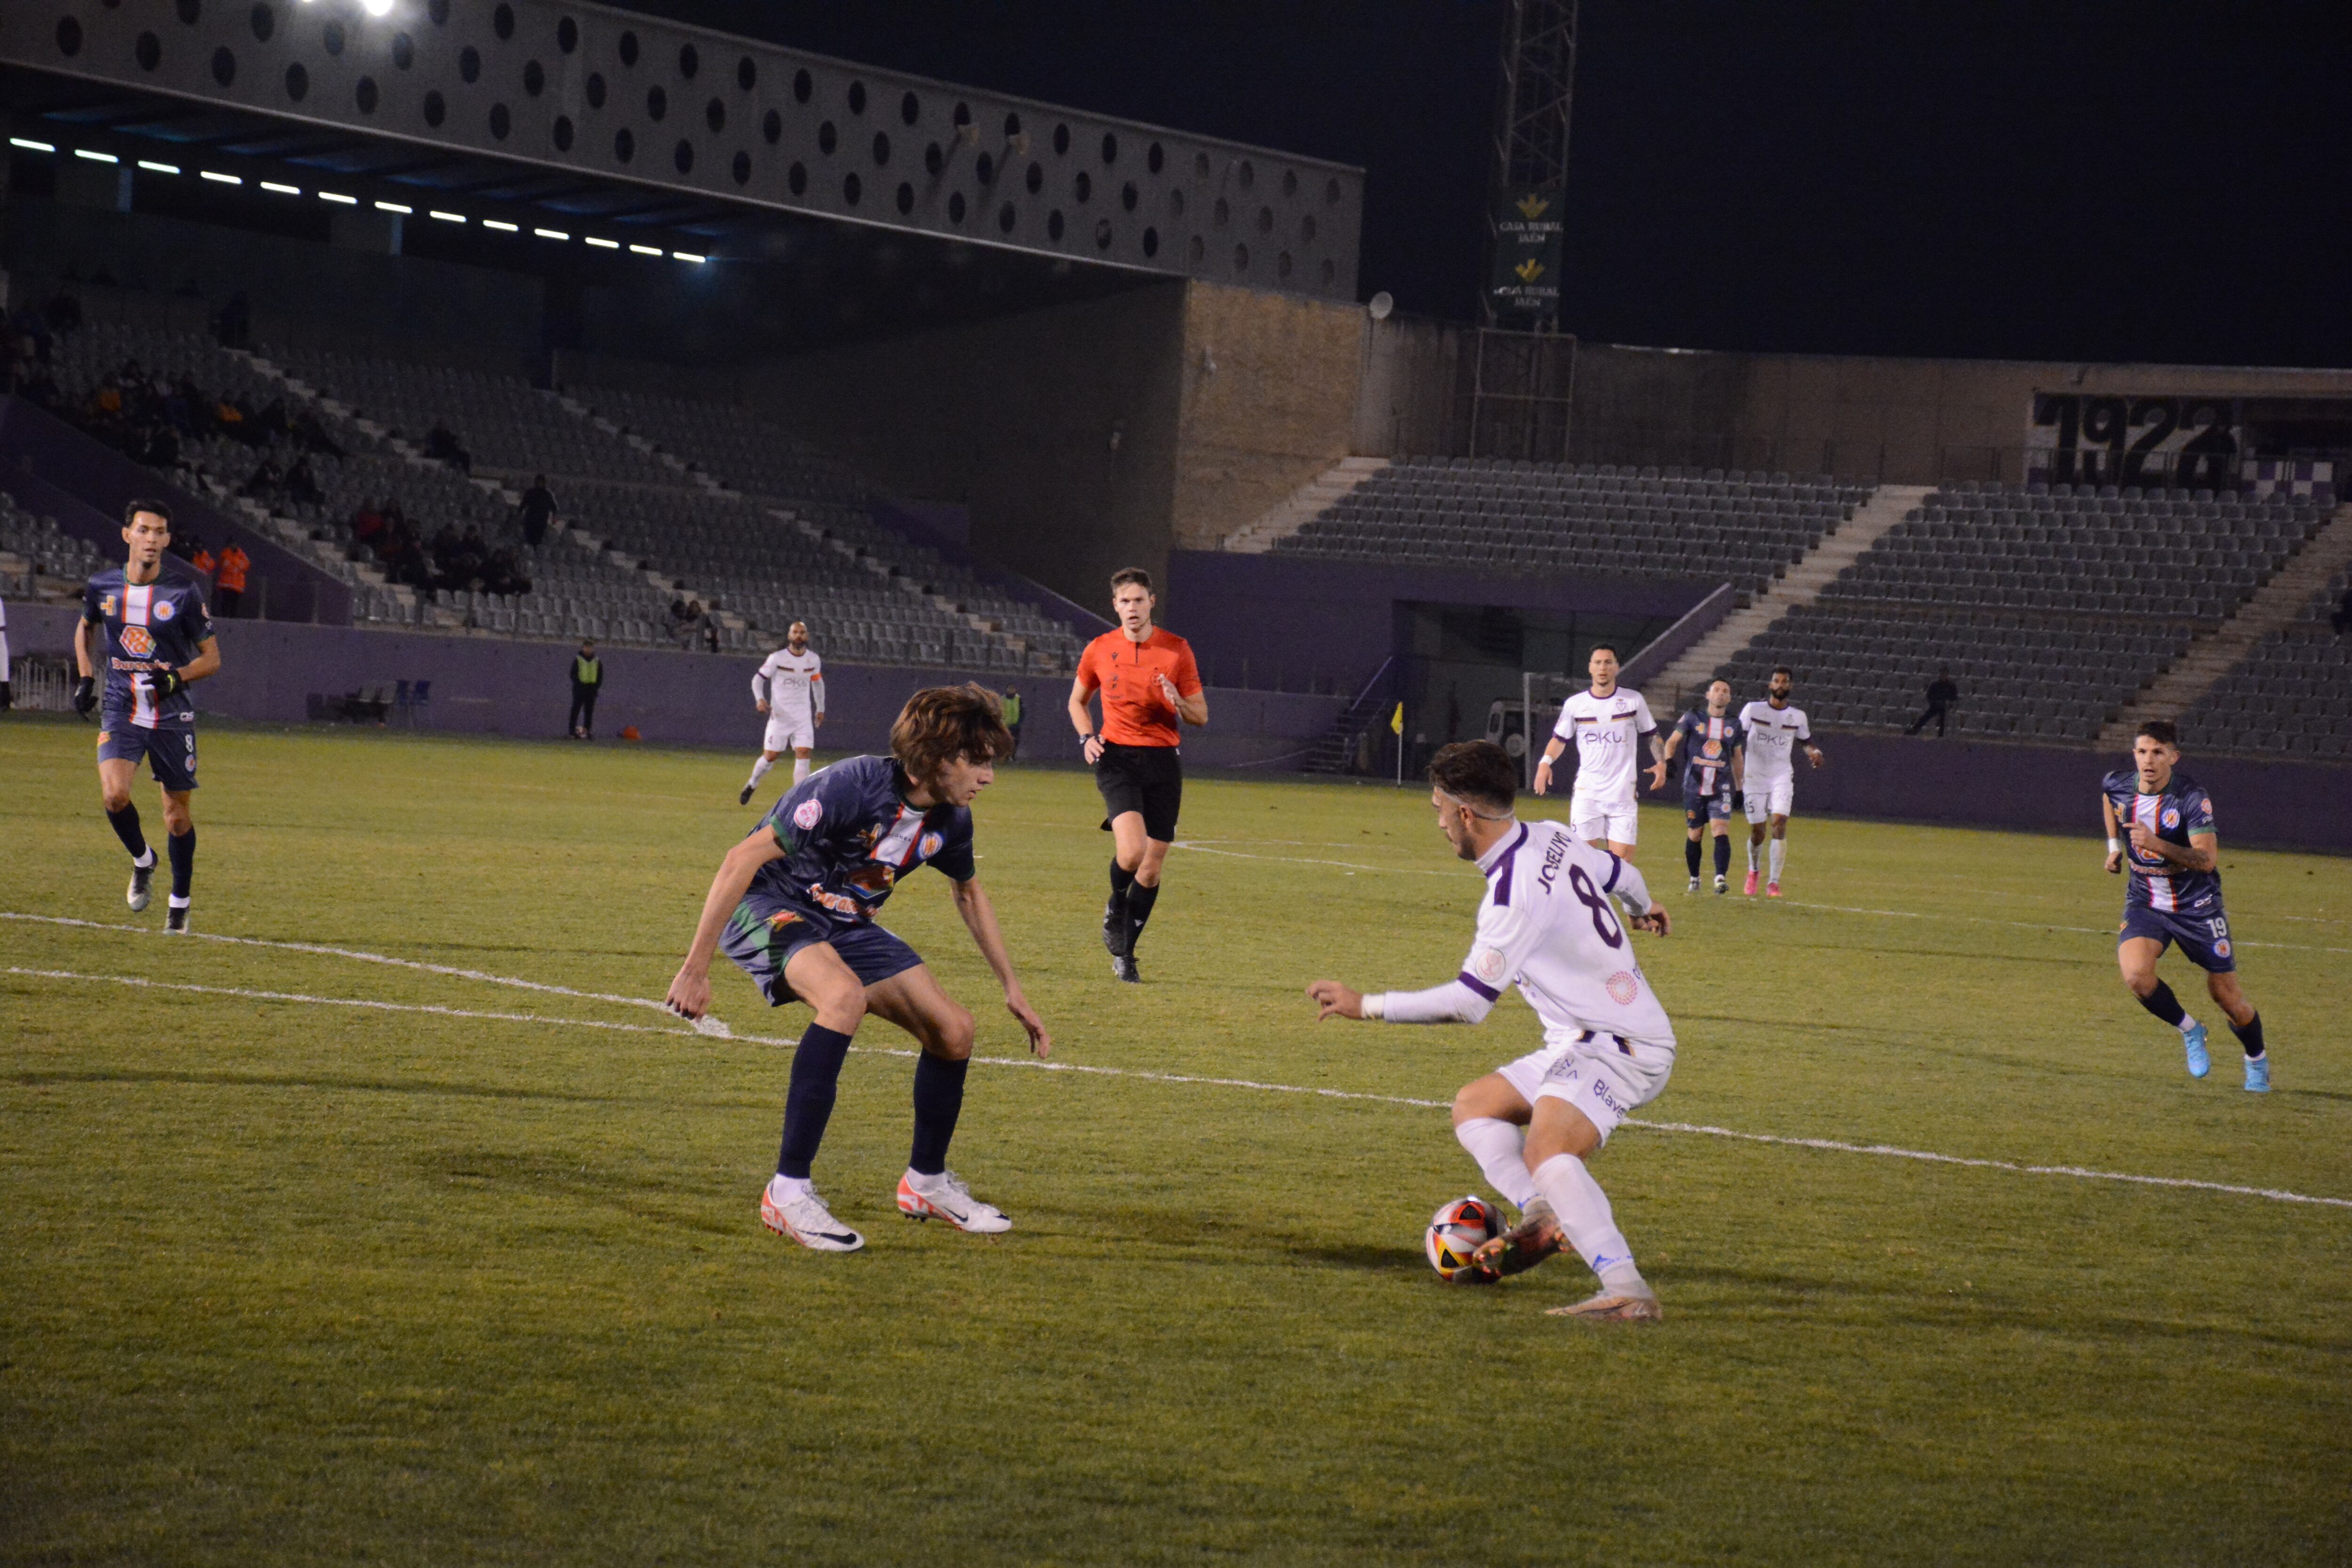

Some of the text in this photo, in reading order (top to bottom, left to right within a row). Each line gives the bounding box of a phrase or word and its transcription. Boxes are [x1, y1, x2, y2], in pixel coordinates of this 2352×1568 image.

[2034, 394, 2238, 489] 1922
[184, 734, 194, 753] 8
[1569, 863, 1623, 949] 8
[2206, 917, 2227, 939] 19
